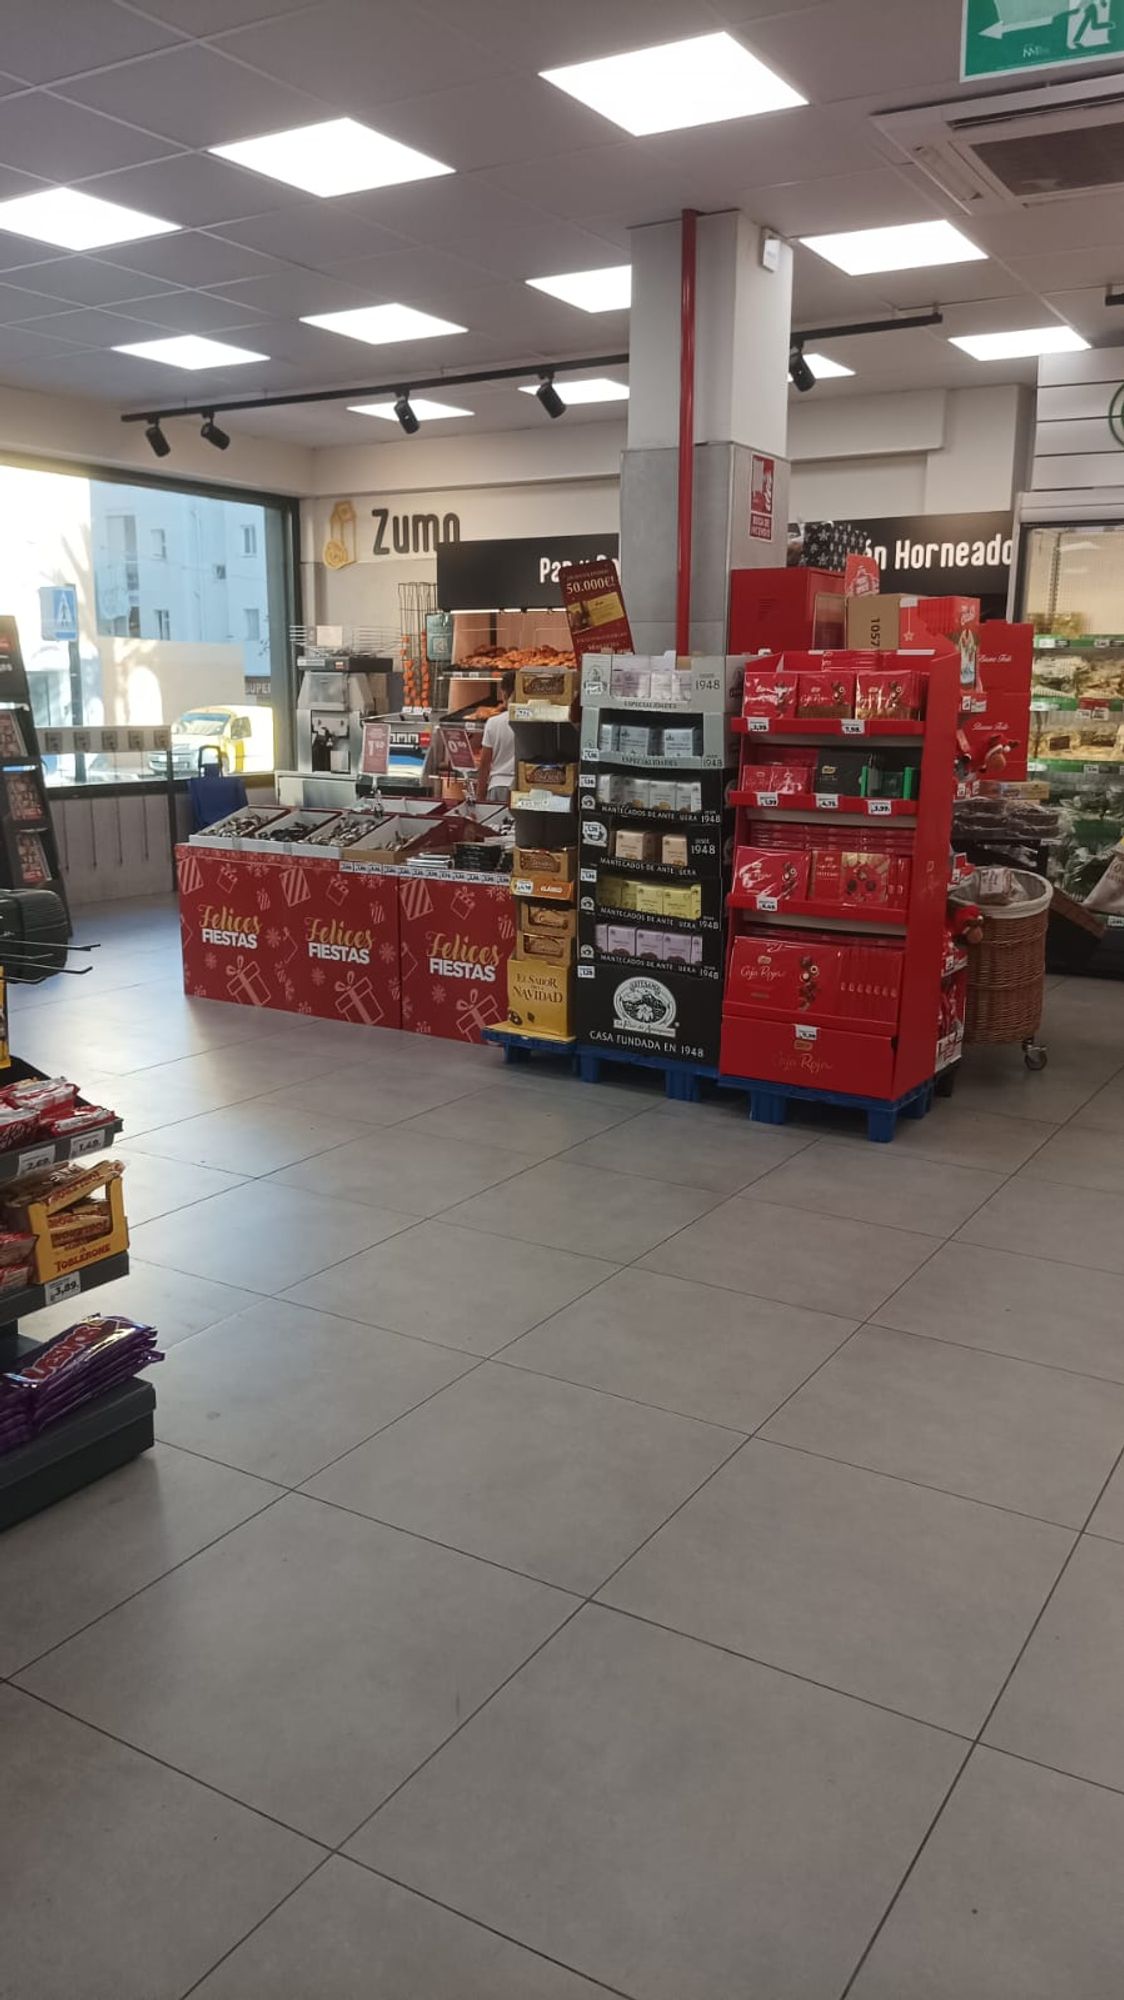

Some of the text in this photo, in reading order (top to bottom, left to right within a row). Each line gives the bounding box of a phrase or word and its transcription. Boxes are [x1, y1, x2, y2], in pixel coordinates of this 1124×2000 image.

[870, 616, 880, 648] 1057
[695, 679, 721, 690] 1948
[691, 844, 716, 854] 1948
[199, 904, 263, 935] Felices
[600, 907, 645, 921] MANTECADOS
[202, 928, 258, 950] FIESTAS
[304, 916, 375, 950] Felices
[308, 942, 371, 965] FIESTAS
[425, 931, 503, 967] Felices
[429, 958, 497, 982] FIESTAS
[513, 985, 564, 1003] NAVIDAD
[589, 1030, 704, 1058] CASA FUNDADA EN 1948
[53, 1243, 111, 1273] TOBLERONE
